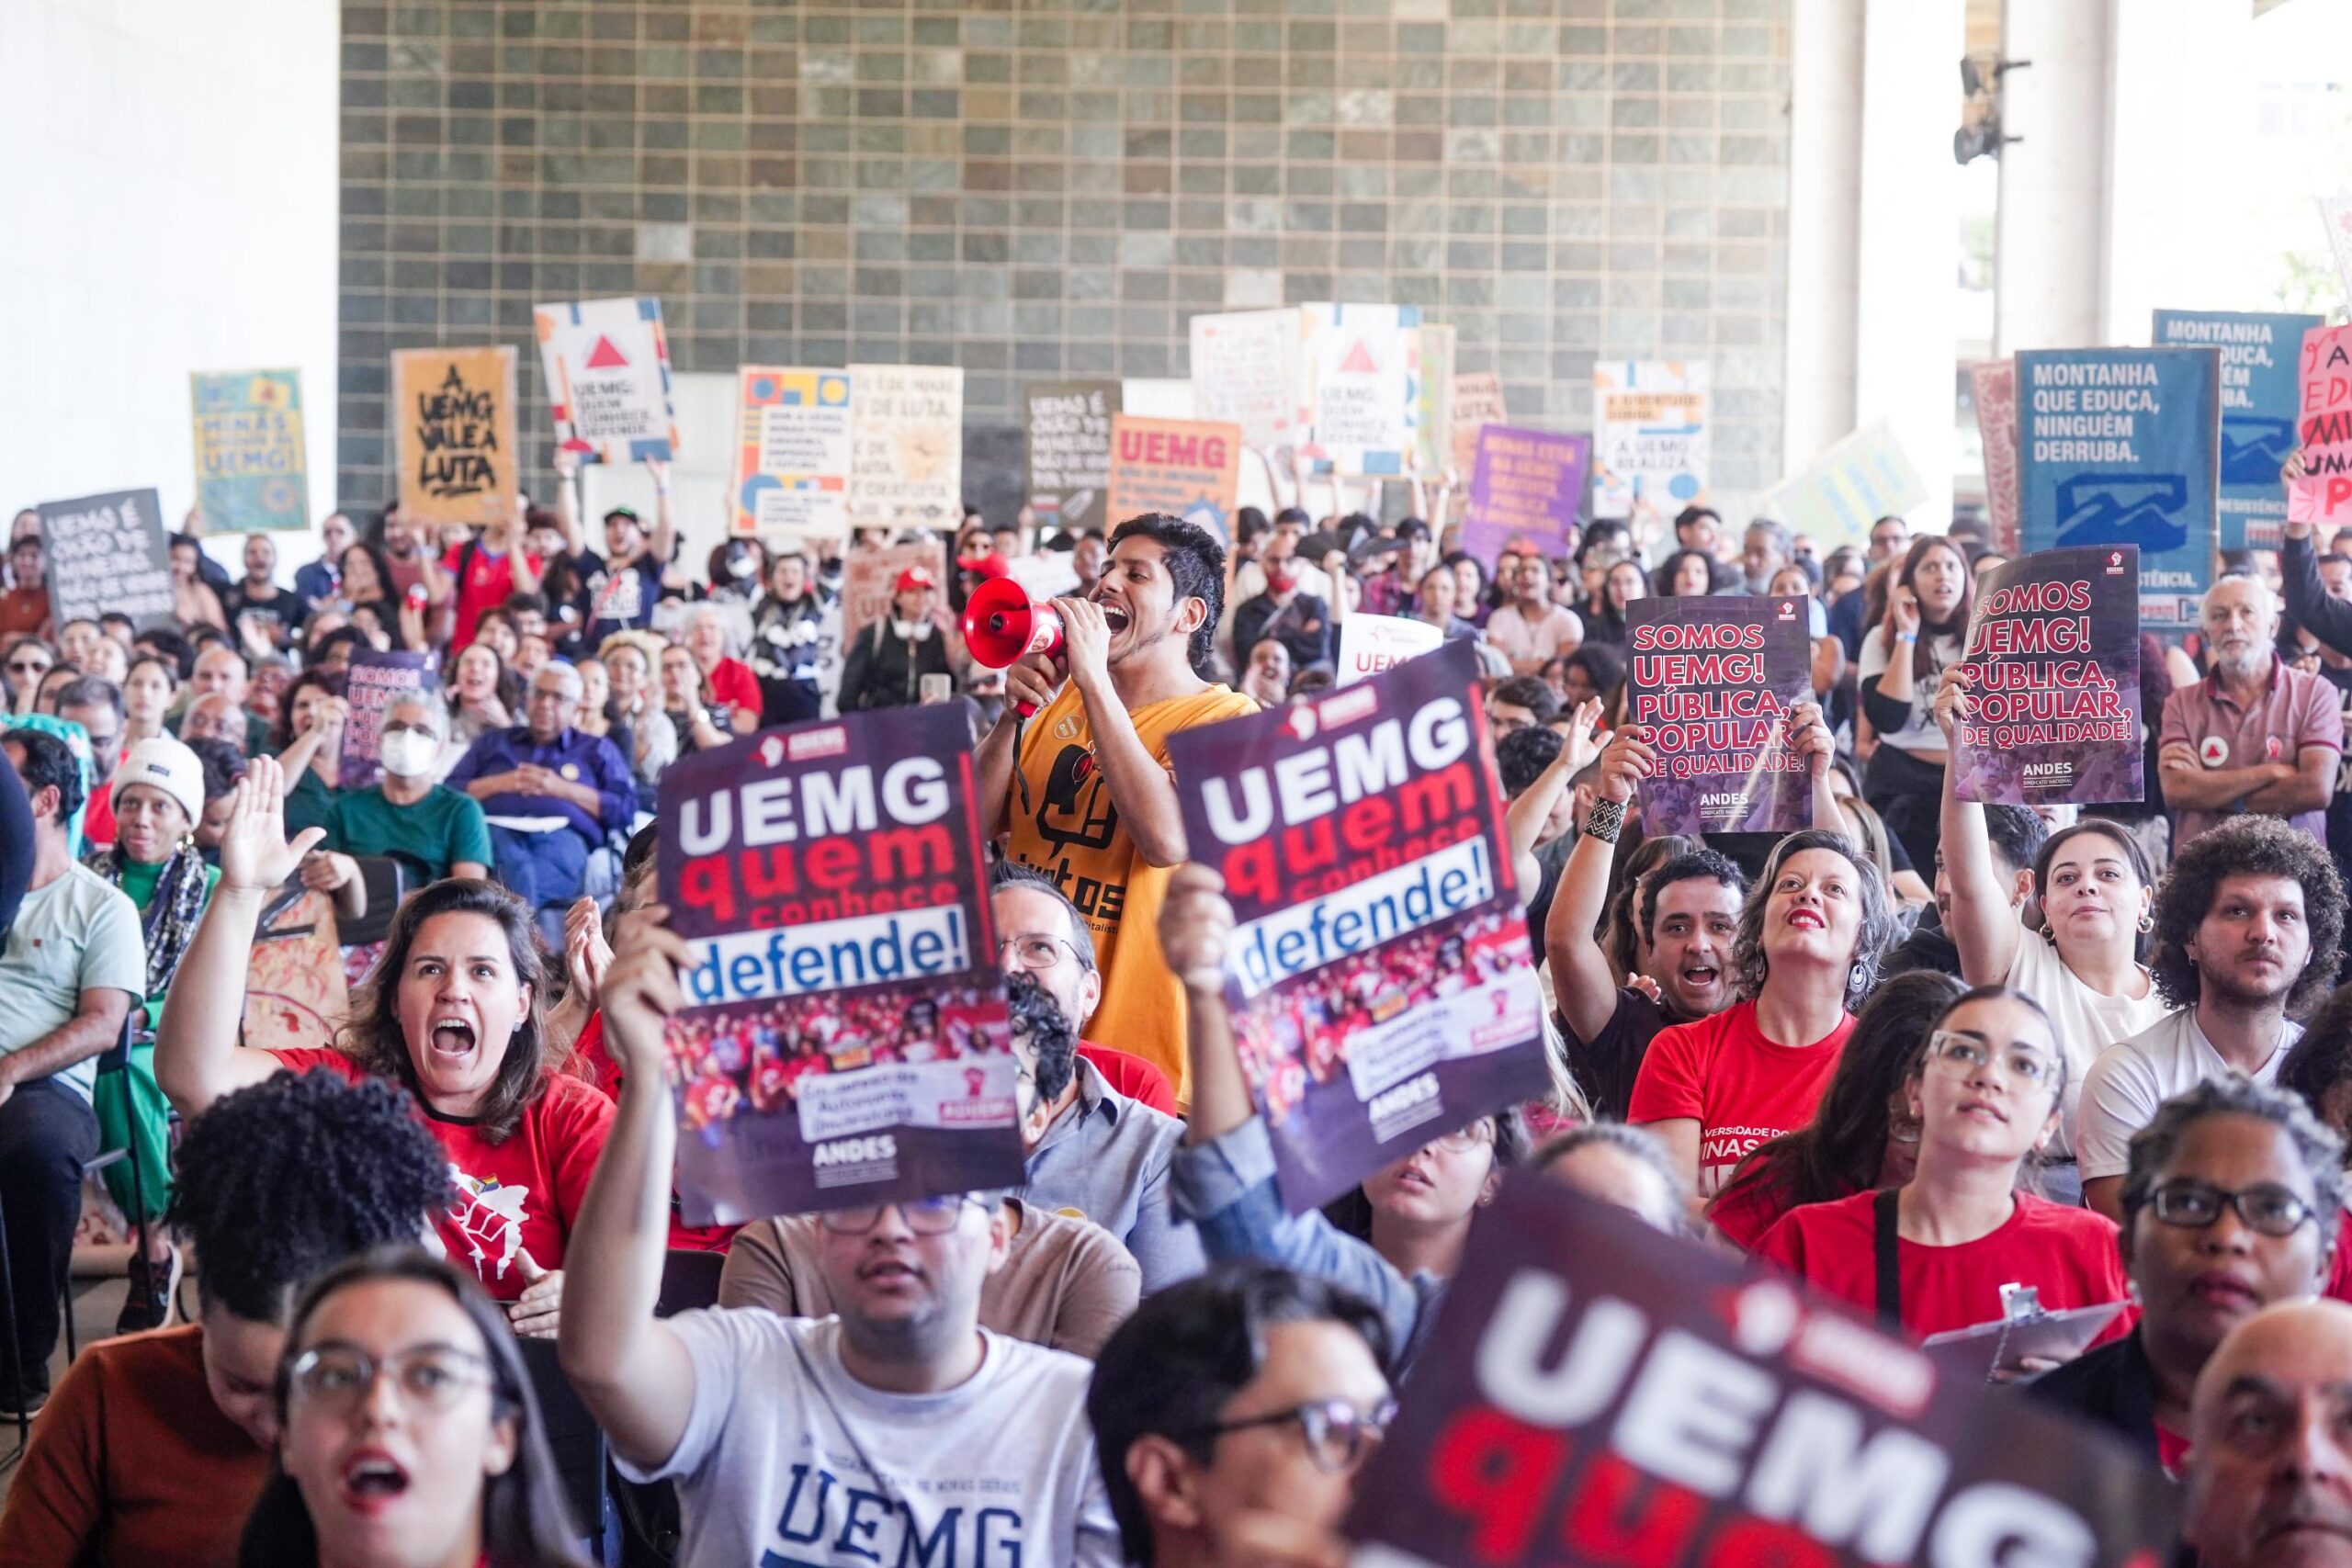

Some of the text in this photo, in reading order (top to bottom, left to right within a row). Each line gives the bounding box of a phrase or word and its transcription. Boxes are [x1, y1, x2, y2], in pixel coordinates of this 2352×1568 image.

[2166, 320, 2273, 344] MONTANHA
[2220, 345, 2274, 368] DUCA,
[2326, 344, 2350, 369] A
[442, 364, 462, 392] A
[2033, 363, 2158, 387] MONTANHA
[419, 391, 495, 422] UEMG
[2033, 389, 2161, 414] QUE EDUCA,
[2304, 377, 2352, 412] ED
[1120, 430, 1227, 469] UEMG
[2034, 441, 2140, 463] DERRUBA.
[420, 456, 496, 490] LUTA
[2140, 569, 2198, 589] TÊNCIA.
[1975, 580, 2092, 623] SOMOS
[1634, 624, 1766, 651] SOMOS
[1966, 616, 2092, 656] UEMG!
[349, 664, 422, 688] SOMOS
[1355, 652, 1409, 673] UEM
[1634, 653, 1767, 688] UEMG!
[1962, 653, 2117, 692] PÚBLICA,
[1637, 685, 1791, 723] PÚBLICA,
[1961, 690, 2133, 724] POPULAR,
[1962, 721, 2133, 750] DE QUALIDADE!
[1200, 696, 1470, 845] UEMG
[1640, 753, 1805, 780] DE QUALIDADE!
[2023, 761, 2073, 776] ANDES
[678, 756, 951, 857] UEMG
[1700, 793, 1748, 806] ANDES
[1222, 761, 1476, 906] quem
[678, 822, 956, 919] quem
[1289, 815, 1481, 904] conhece
[749, 879, 958, 931] conhece
[1241, 845, 1486, 988] defende!
[688, 911, 965, 1002] defende!
[1705, 1125, 1770, 1138] VERSIDADE
[813, 1134, 898, 1168] ANDES
[1701, 1138, 1759, 1161] INAS
[1477, 1268, 2098, 1568] UEMG
[778, 1463, 1023, 1568] UEMG
